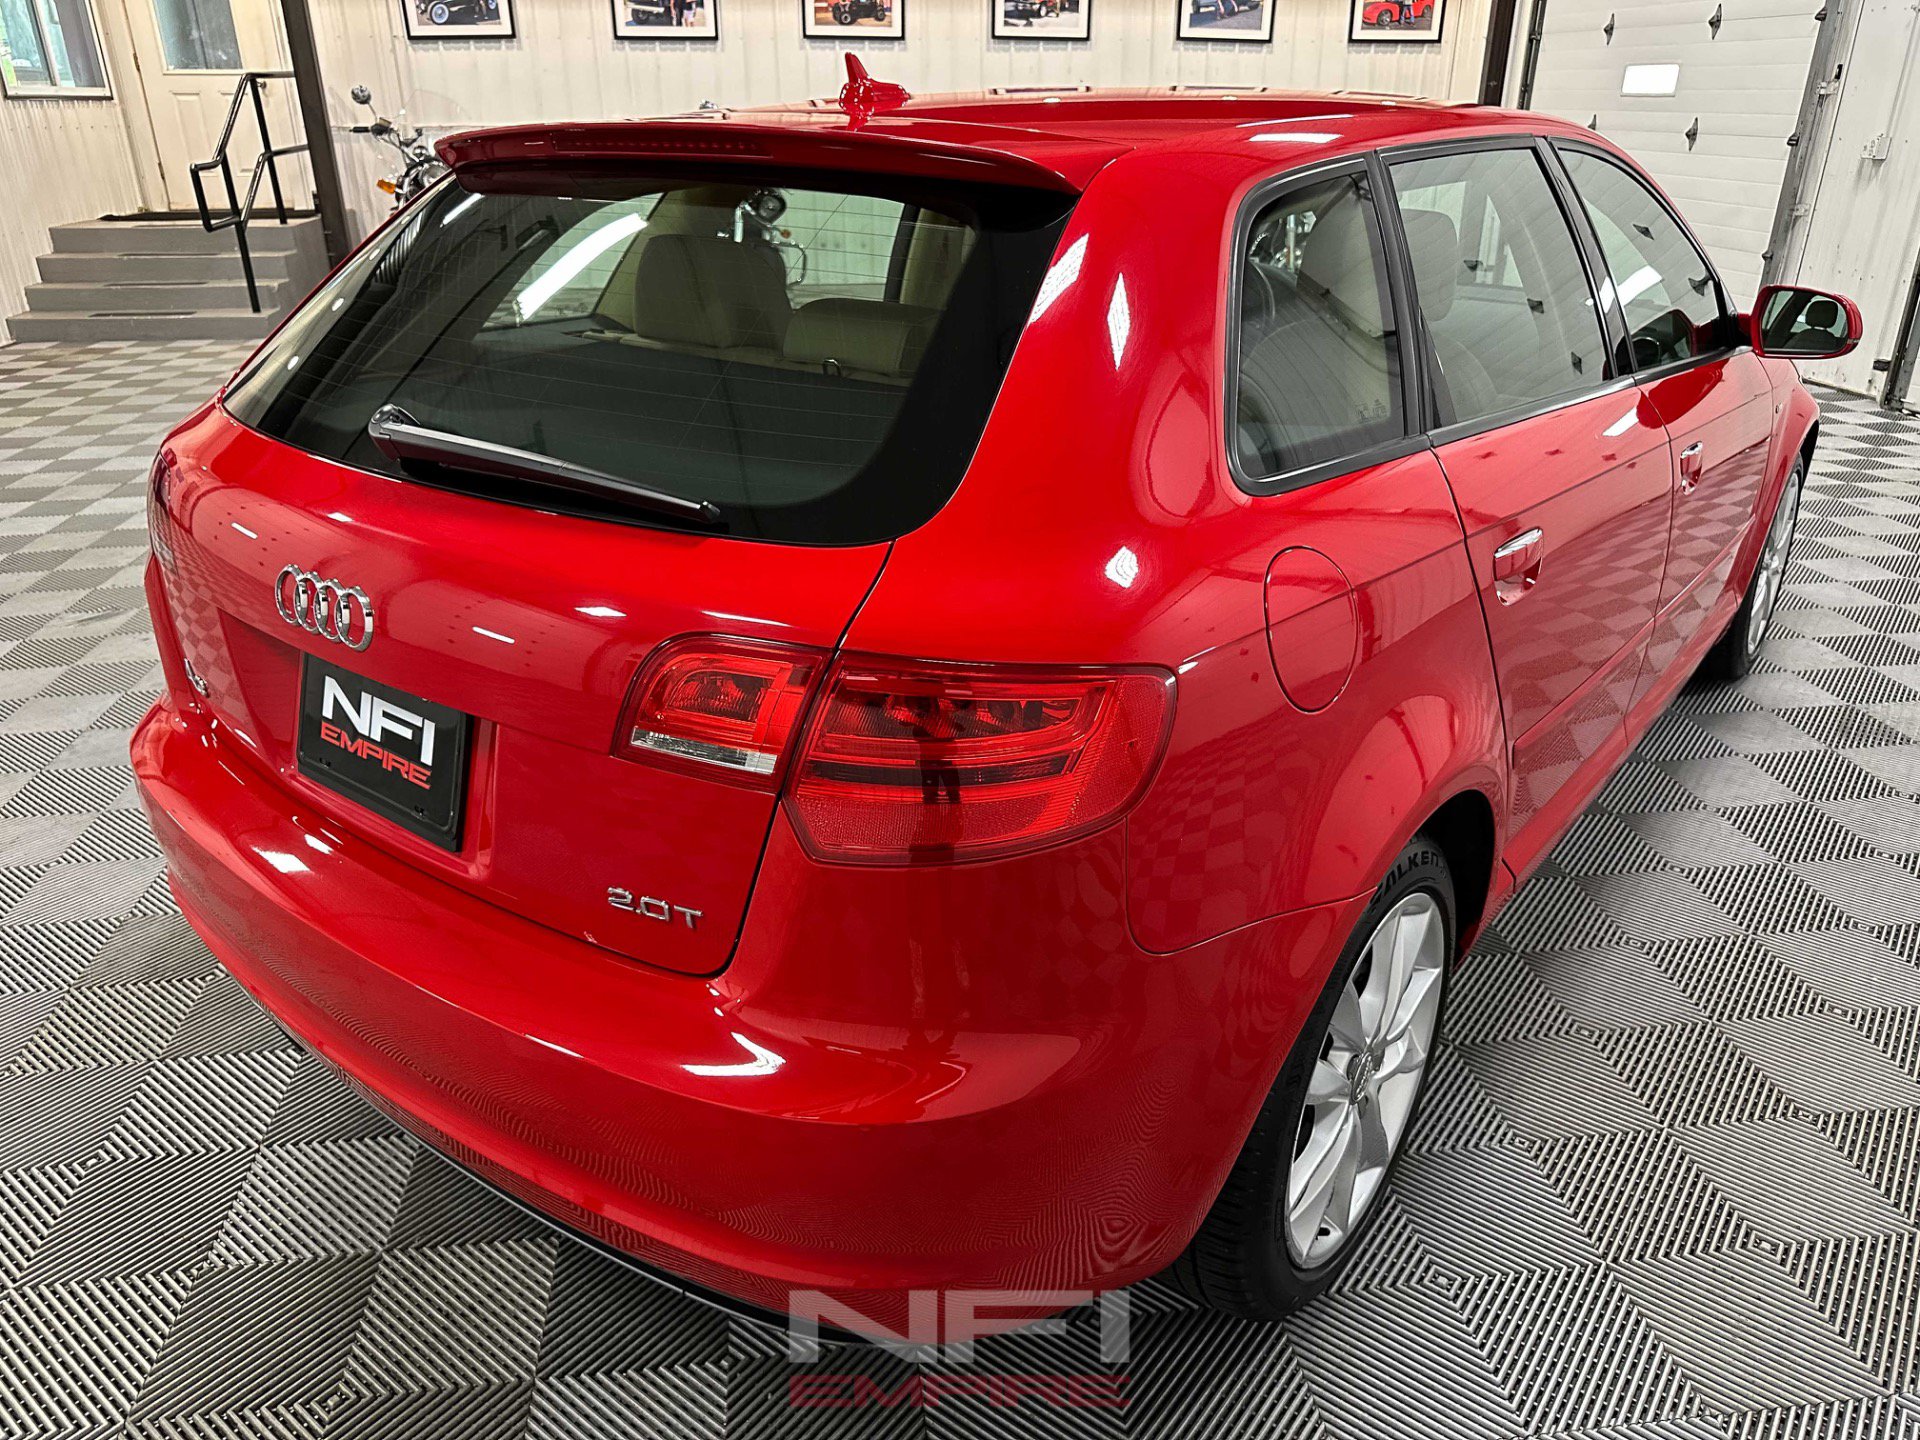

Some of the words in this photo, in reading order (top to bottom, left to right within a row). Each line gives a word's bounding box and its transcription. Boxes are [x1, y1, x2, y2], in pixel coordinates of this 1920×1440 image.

[320, 721, 432, 790] EMPIRE
[321, 675, 436, 767] NFI
[607, 887, 703, 929] 2.0T
